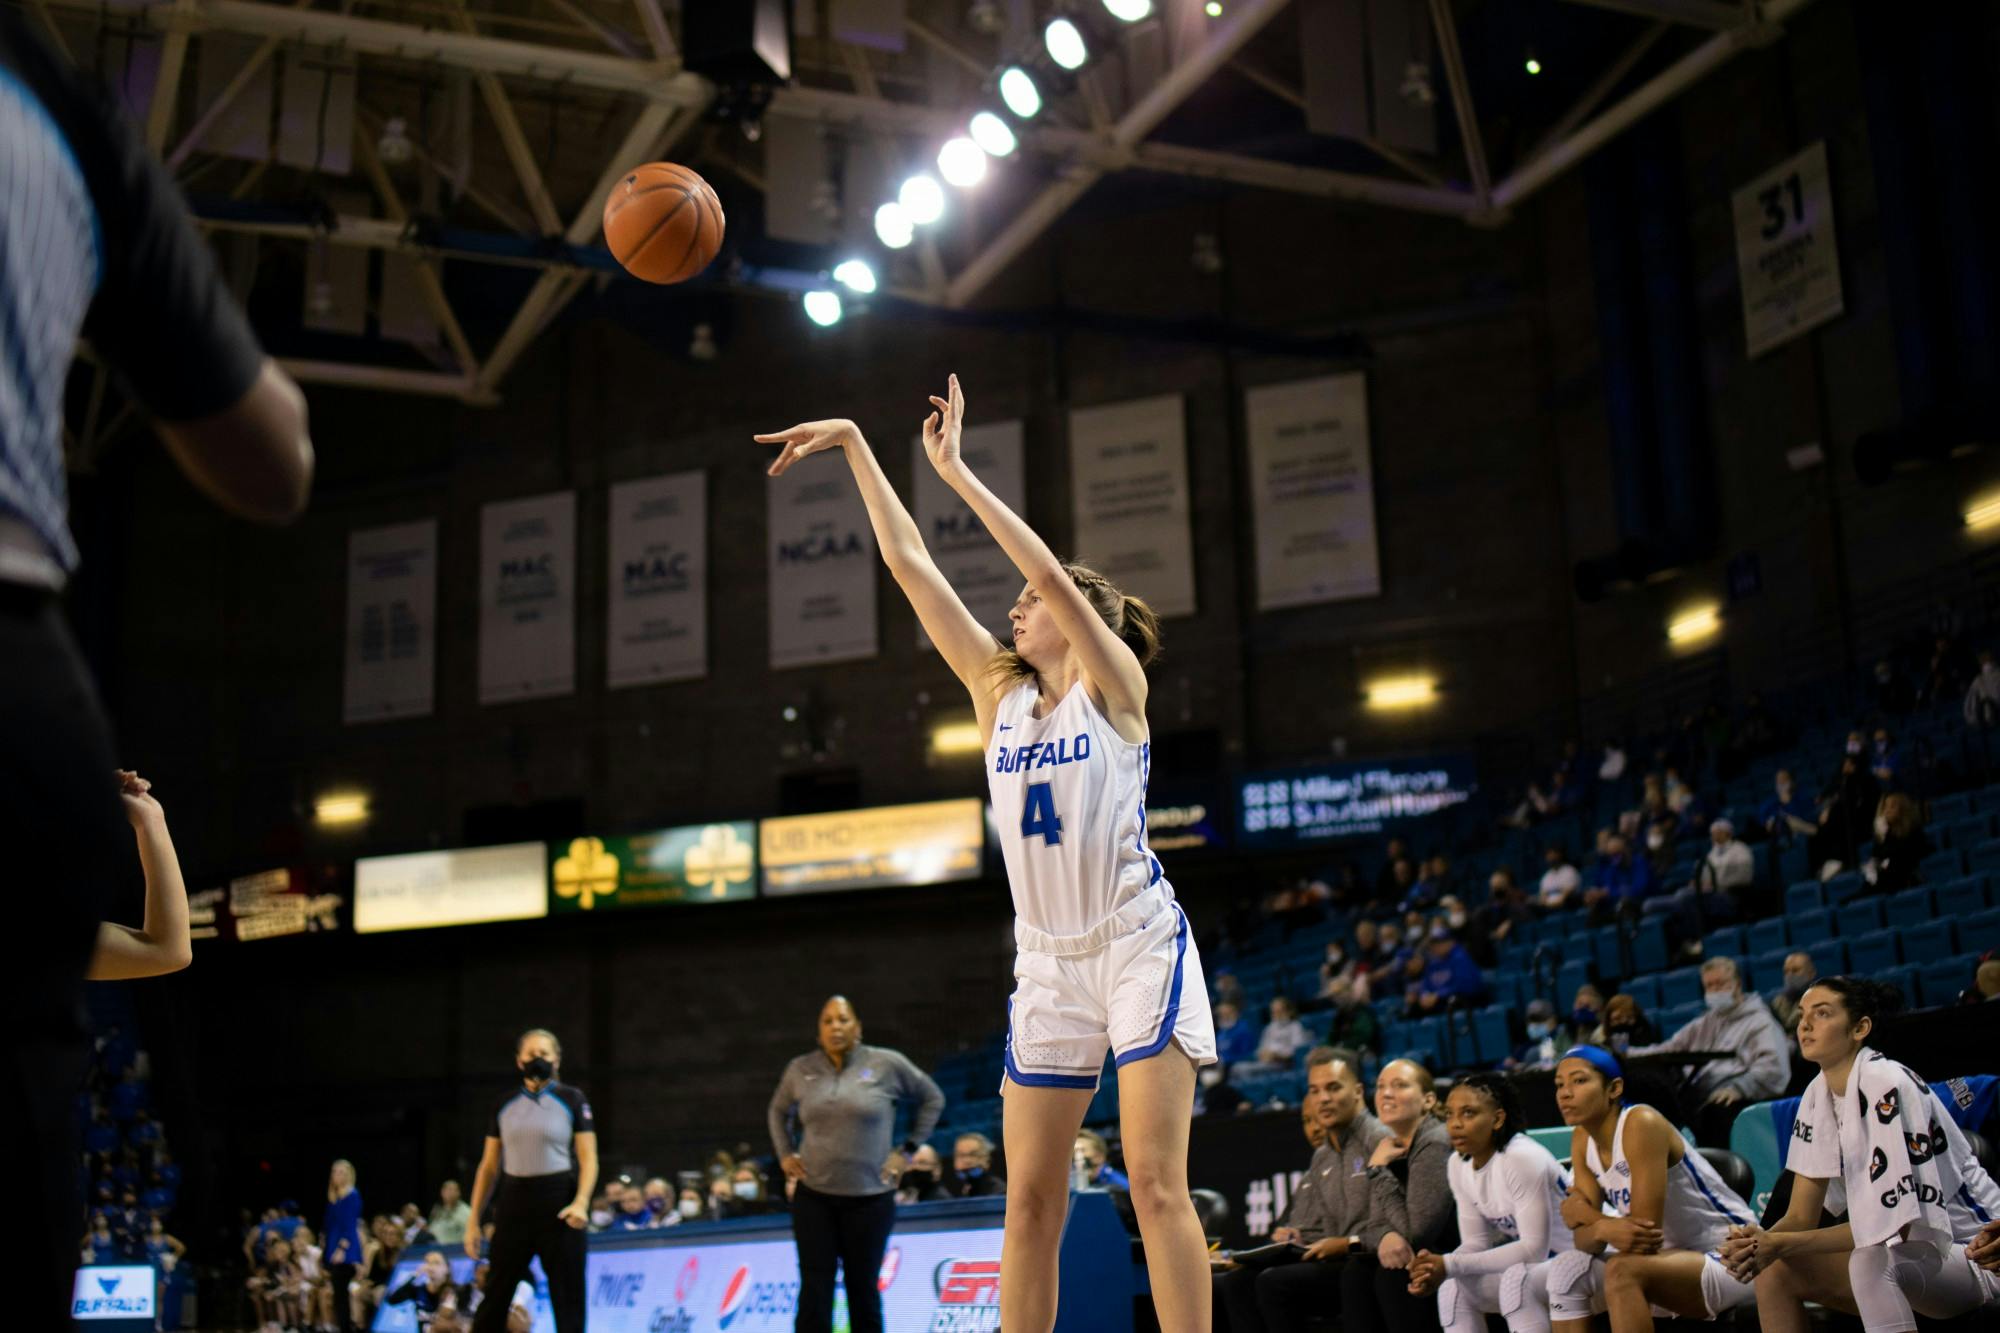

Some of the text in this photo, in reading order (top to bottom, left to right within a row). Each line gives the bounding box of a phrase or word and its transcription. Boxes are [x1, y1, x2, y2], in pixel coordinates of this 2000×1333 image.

[1759, 172, 1804, 240] 31
[500, 553, 551, 578] MAC
[779, 532, 862, 562] NCAA
[623, 552, 689, 584] MAC
[996, 733, 1090, 773] BUFFALO
[1021, 782, 1063, 849] 4
[744, 1281, 800, 1324] peps
